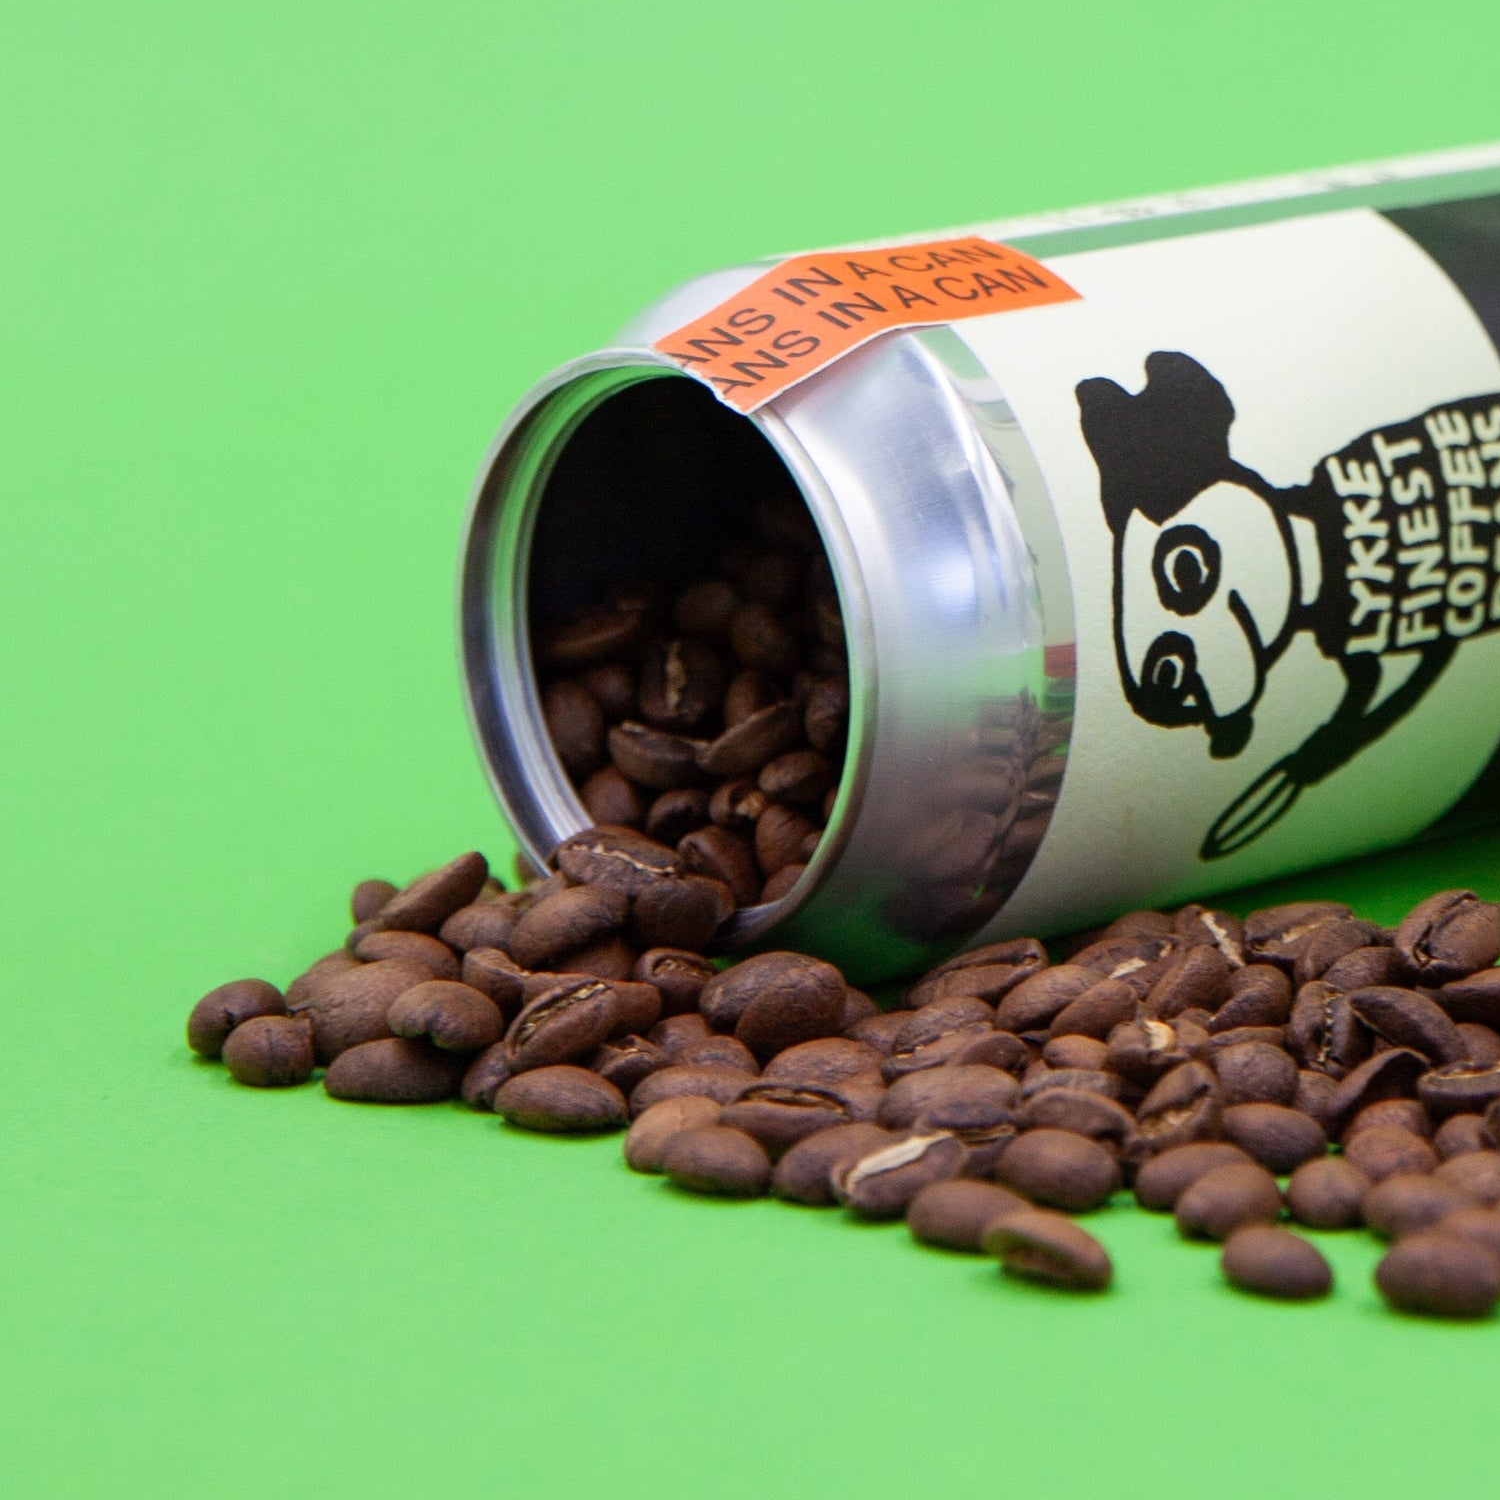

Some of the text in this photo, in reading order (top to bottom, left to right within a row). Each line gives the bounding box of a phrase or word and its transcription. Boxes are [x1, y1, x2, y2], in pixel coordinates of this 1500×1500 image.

[773, 265, 842, 307] IN
[846, 259, 892, 282] A
[888, 242, 1005, 273] CAN
[817, 291, 888, 330] IN
[890, 283, 938, 310] A
[934, 265, 1050, 302] CAN
[1325, 455, 1395, 655] LYKKE
[1372, 432, 1448, 648] FINEST
[1424, 409, 1494, 638] COFFEE
